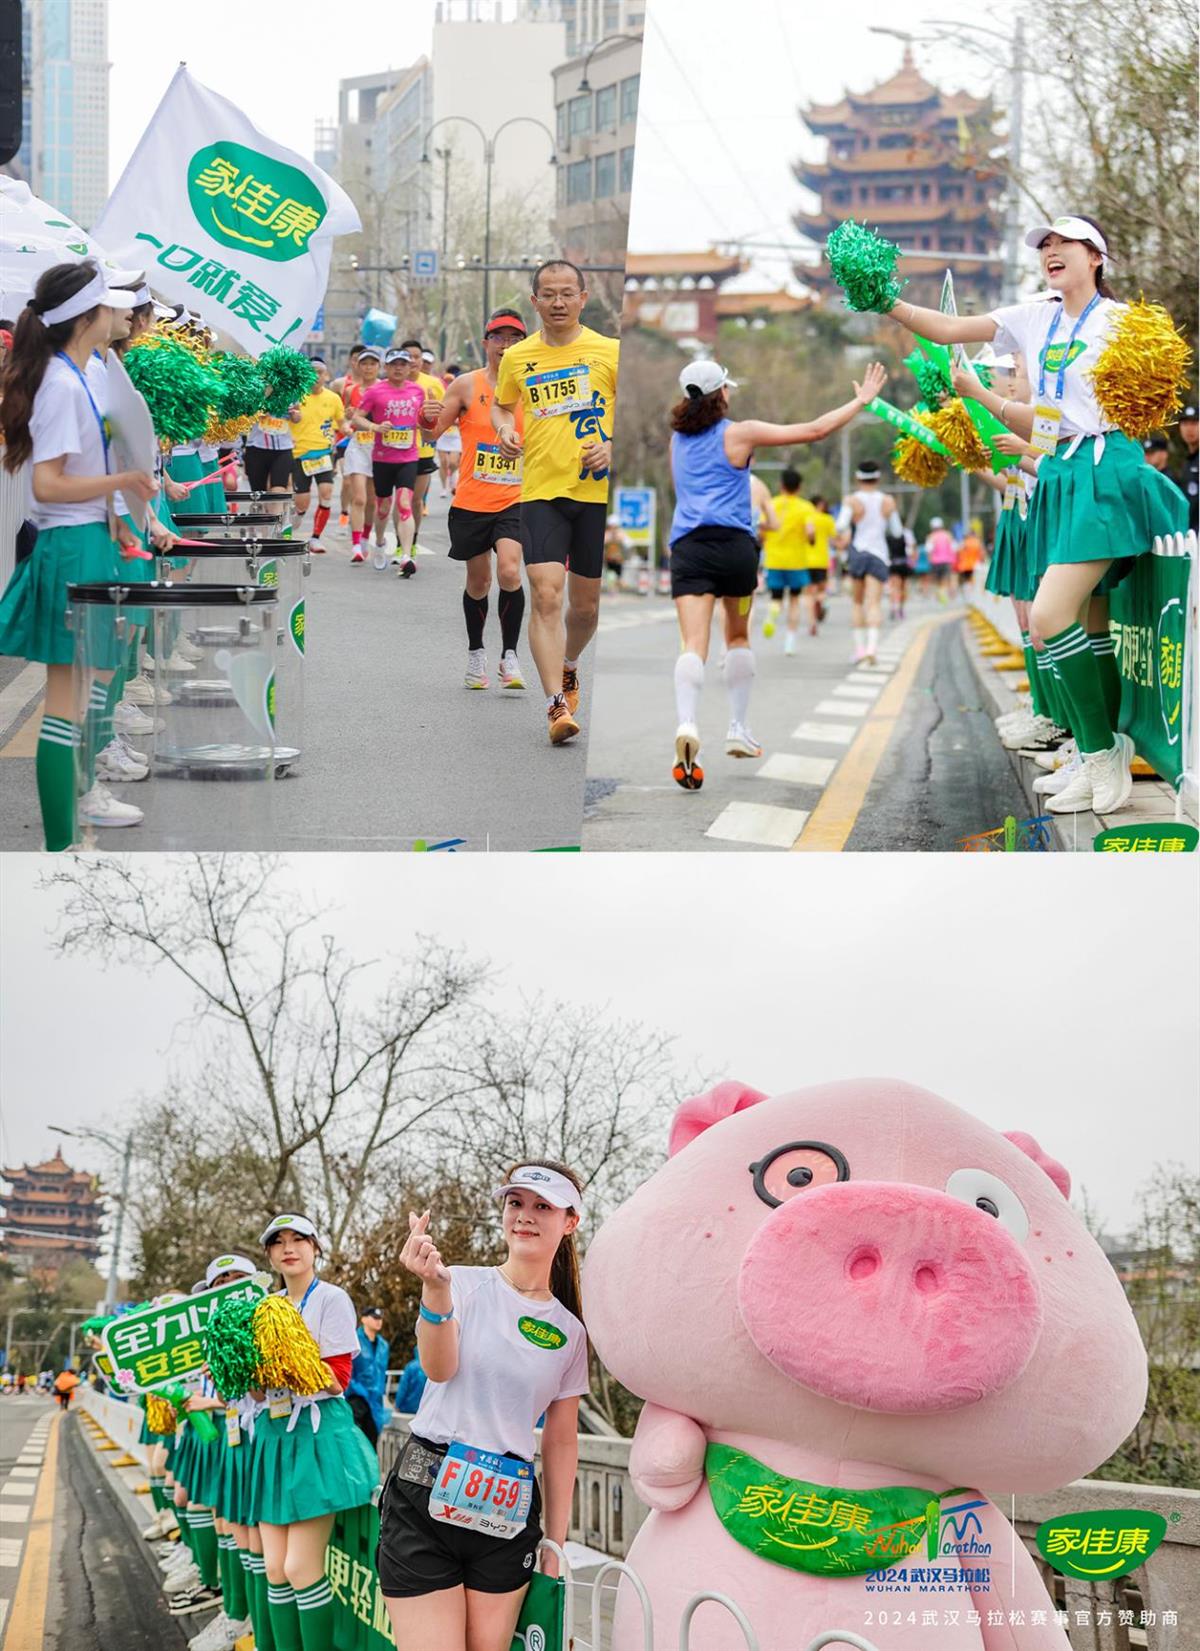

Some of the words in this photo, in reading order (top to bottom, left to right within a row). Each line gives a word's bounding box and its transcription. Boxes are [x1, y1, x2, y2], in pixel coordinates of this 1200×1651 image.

[195, 157, 323, 246] 家佳康
[529, 387, 540, 403] B
[543, 379, 576, 400] 1755
[476, 453, 485, 467] B
[135, 1340, 206, 1386] 安全
[440, 1460, 461, 1489] F
[464, 1468, 521, 1509] 8159
[738, 1485, 873, 1536] 家佳康
